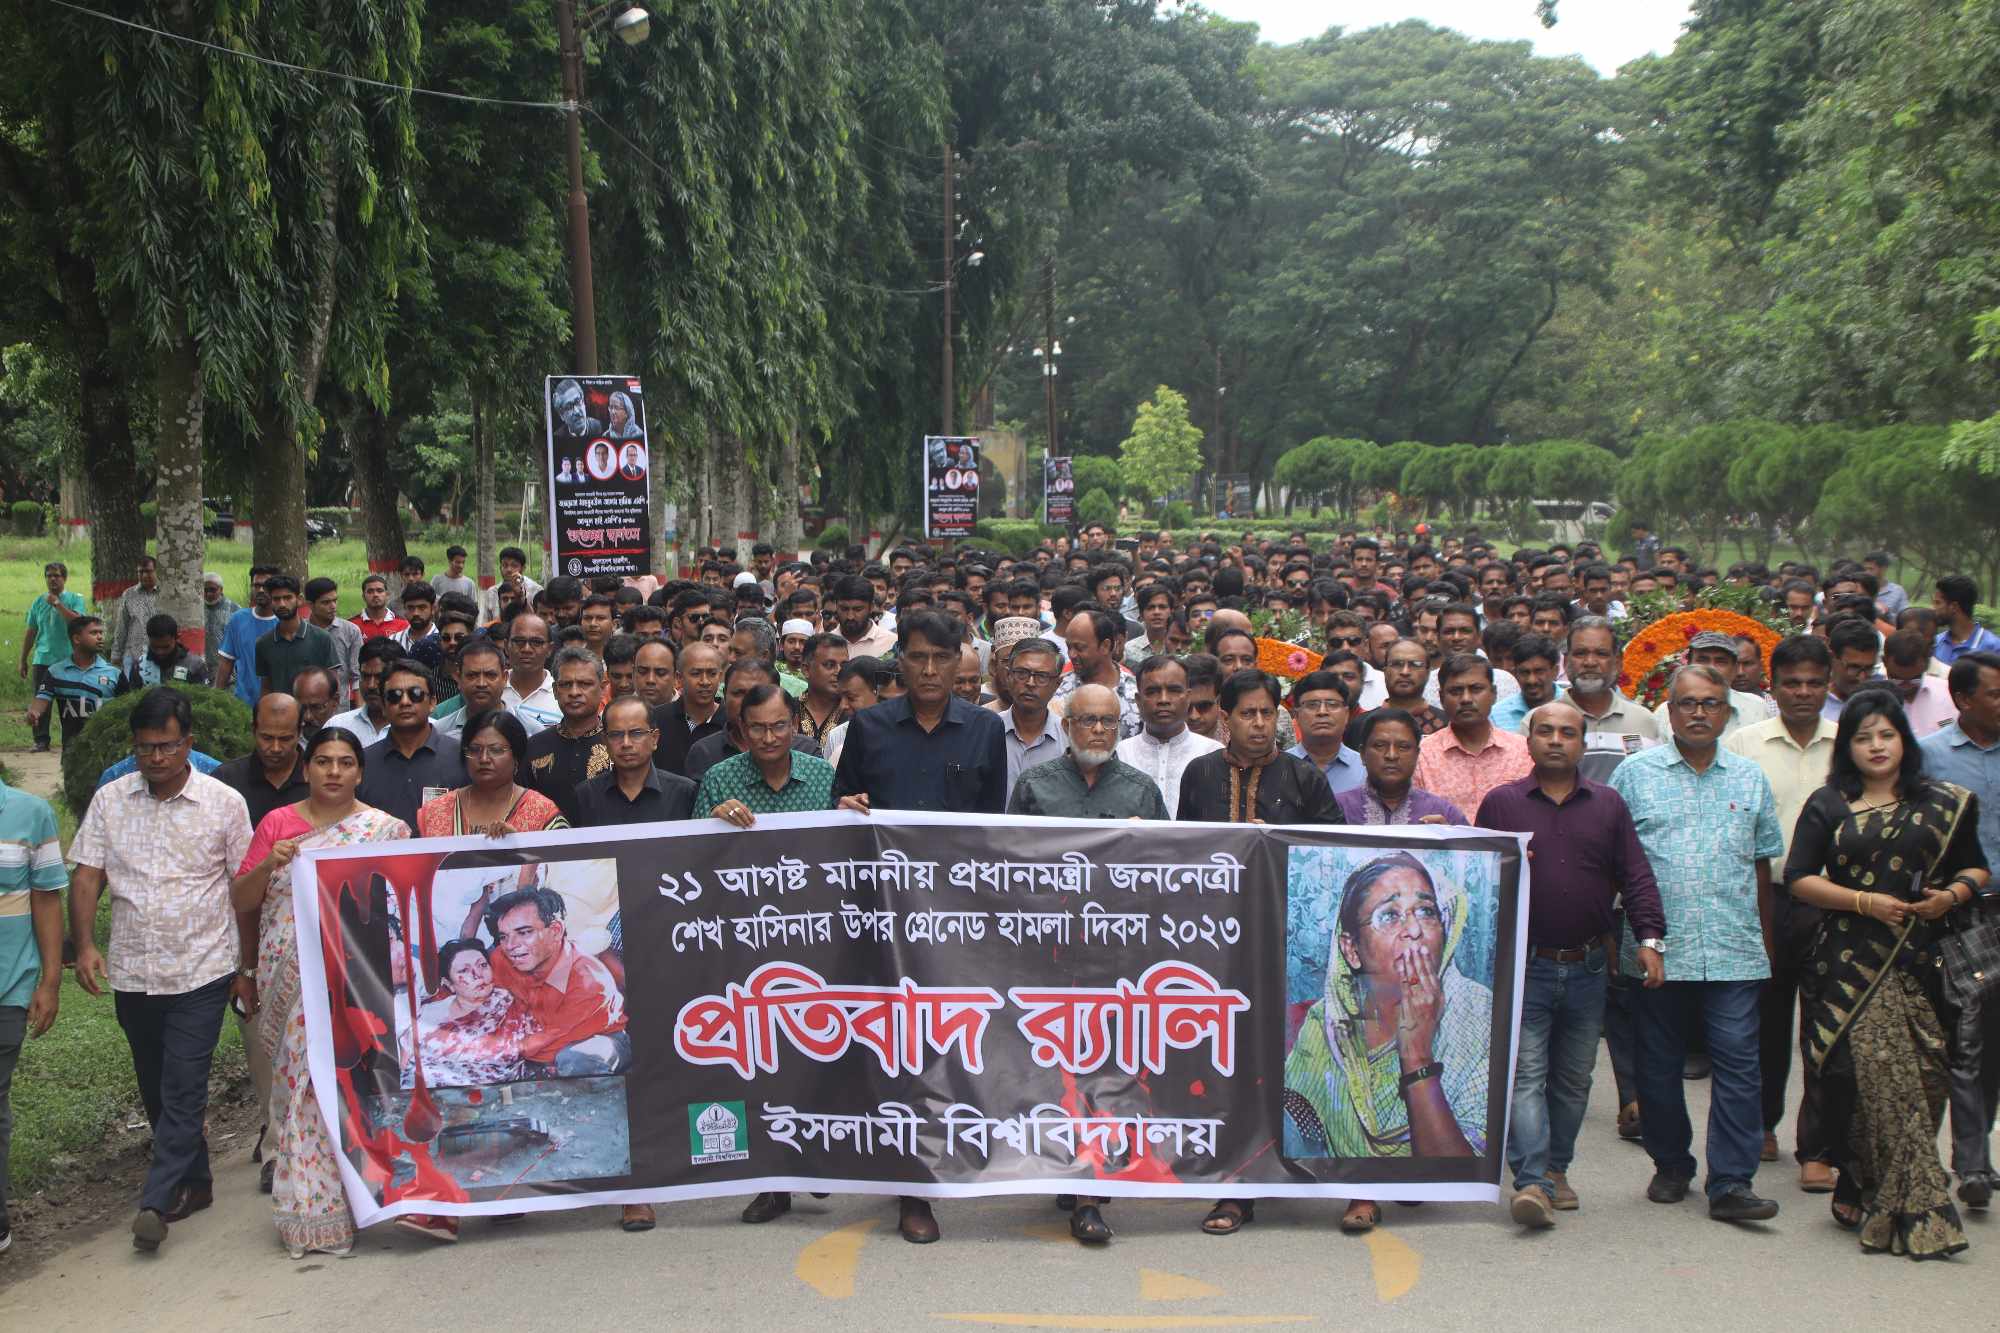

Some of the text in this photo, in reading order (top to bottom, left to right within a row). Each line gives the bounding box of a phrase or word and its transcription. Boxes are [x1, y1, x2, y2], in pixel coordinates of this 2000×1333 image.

[658, 872, 703, 905] ২১
[819, 848, 940, 892] মাননীয়
[949, 851, 1098, 894] প্রধানমন্ত্রী
[1105, 852, 1247, 894] জননেত্রী
[671, 900, 1241, 952] শেখ হাসিনার উপর গ্রেনেড হামলা দিবস ২০২৩
[673, 960, 1005, 1081] প্রতিবাদ
[760, 1101, 1226, 1158] ইসলামী বিশ্ববিদ্যালয়
